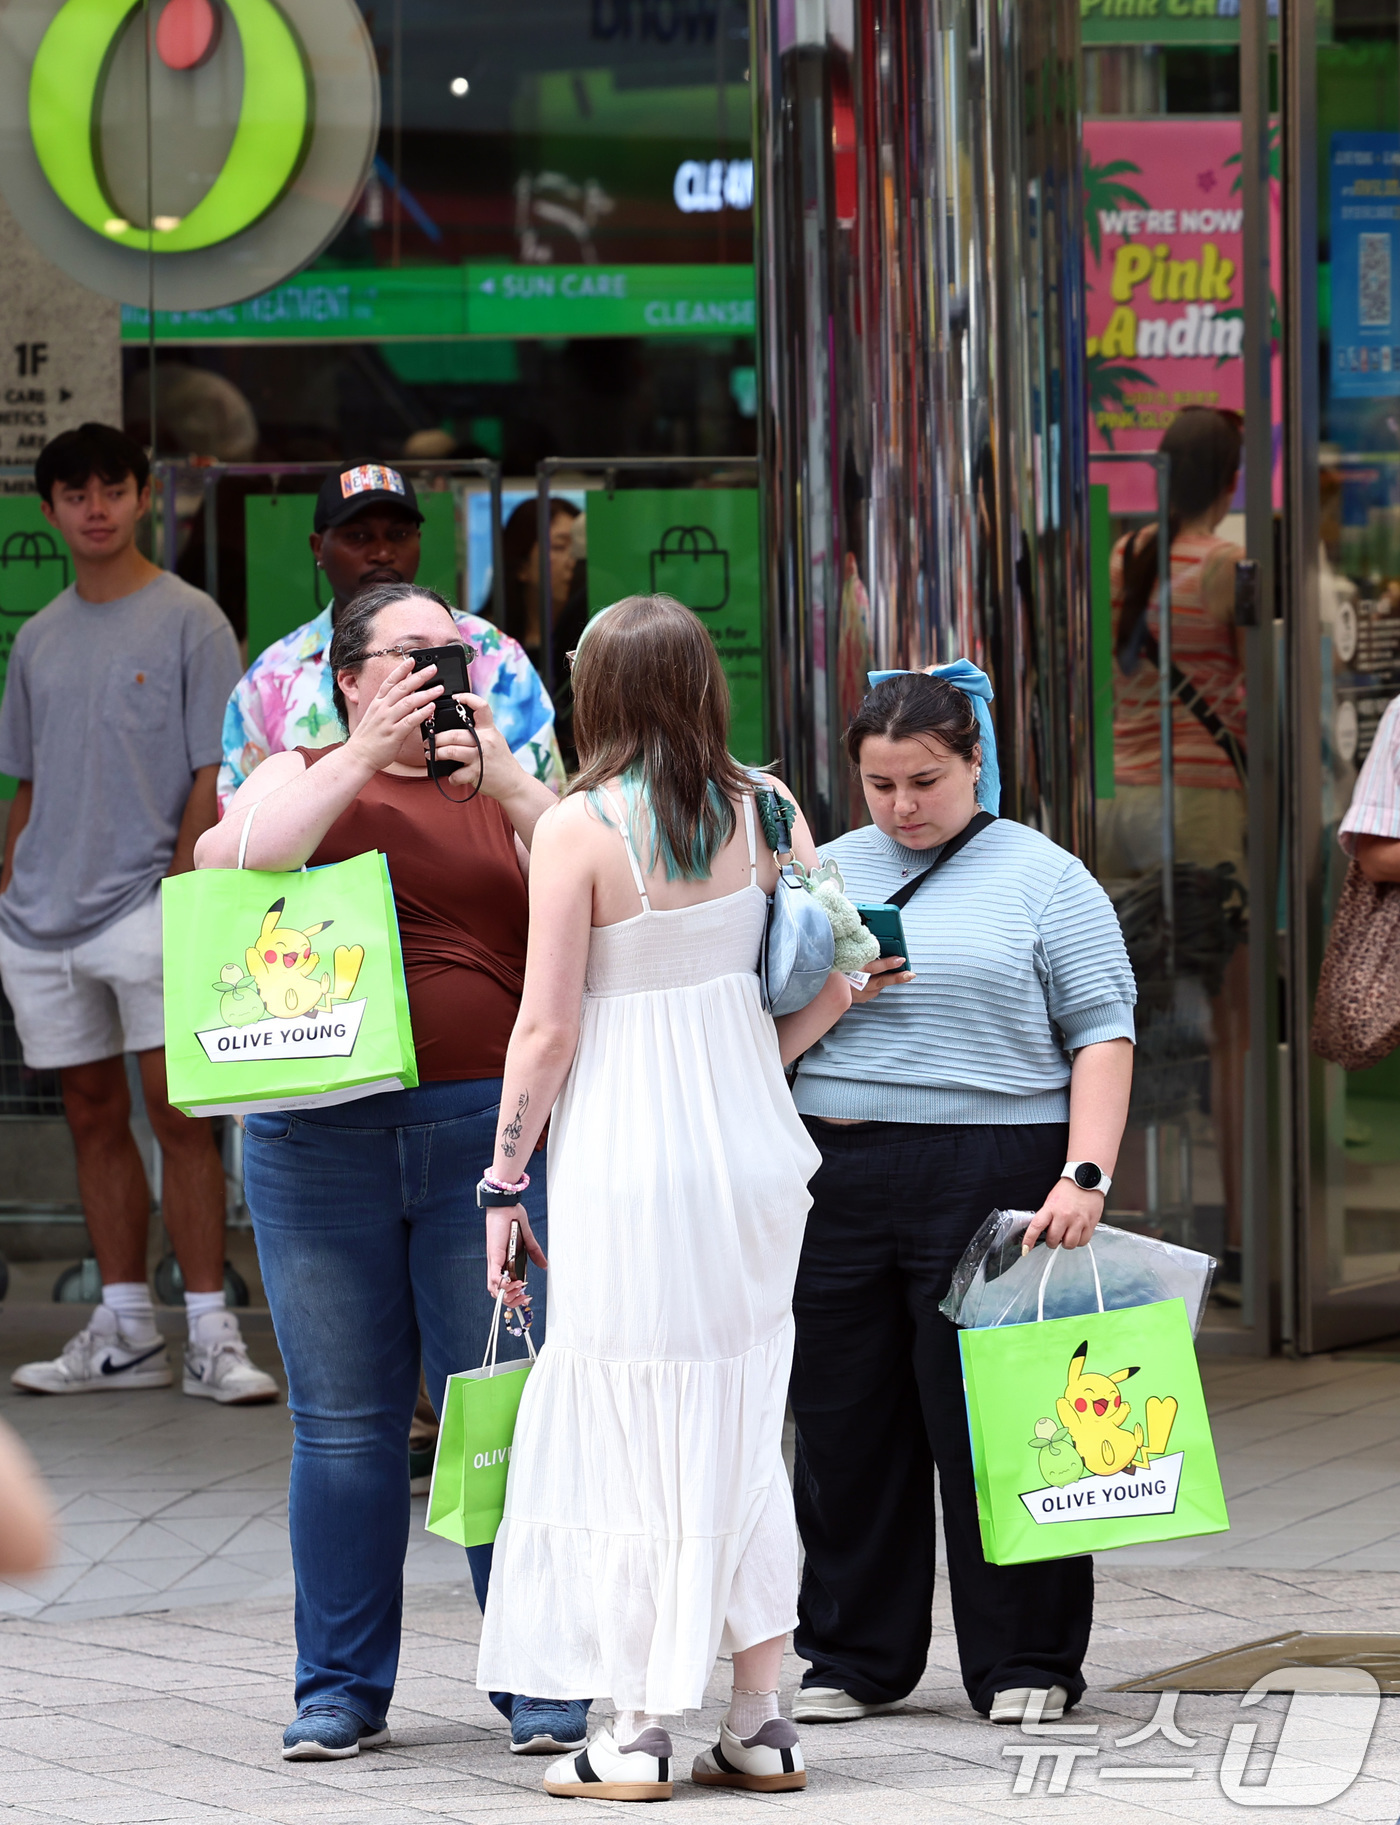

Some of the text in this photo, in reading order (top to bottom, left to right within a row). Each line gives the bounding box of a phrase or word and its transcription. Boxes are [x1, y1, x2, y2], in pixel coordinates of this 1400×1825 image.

[1099, 209, 1243, 235] WE'RE NOW
[502, 274, 627, 298] SUN CARE
[1110, 243, 1236, 304] Pink
[1087, 303, 1244, 361] Andin
[15, 343, 48, 377] 1F
[5, 388, 46, 405] CARE
[217, 1023, 346, 1052] OLIVE YOUNG
[1042, 1480, 1167, 1513] OLIVE YOUNG
